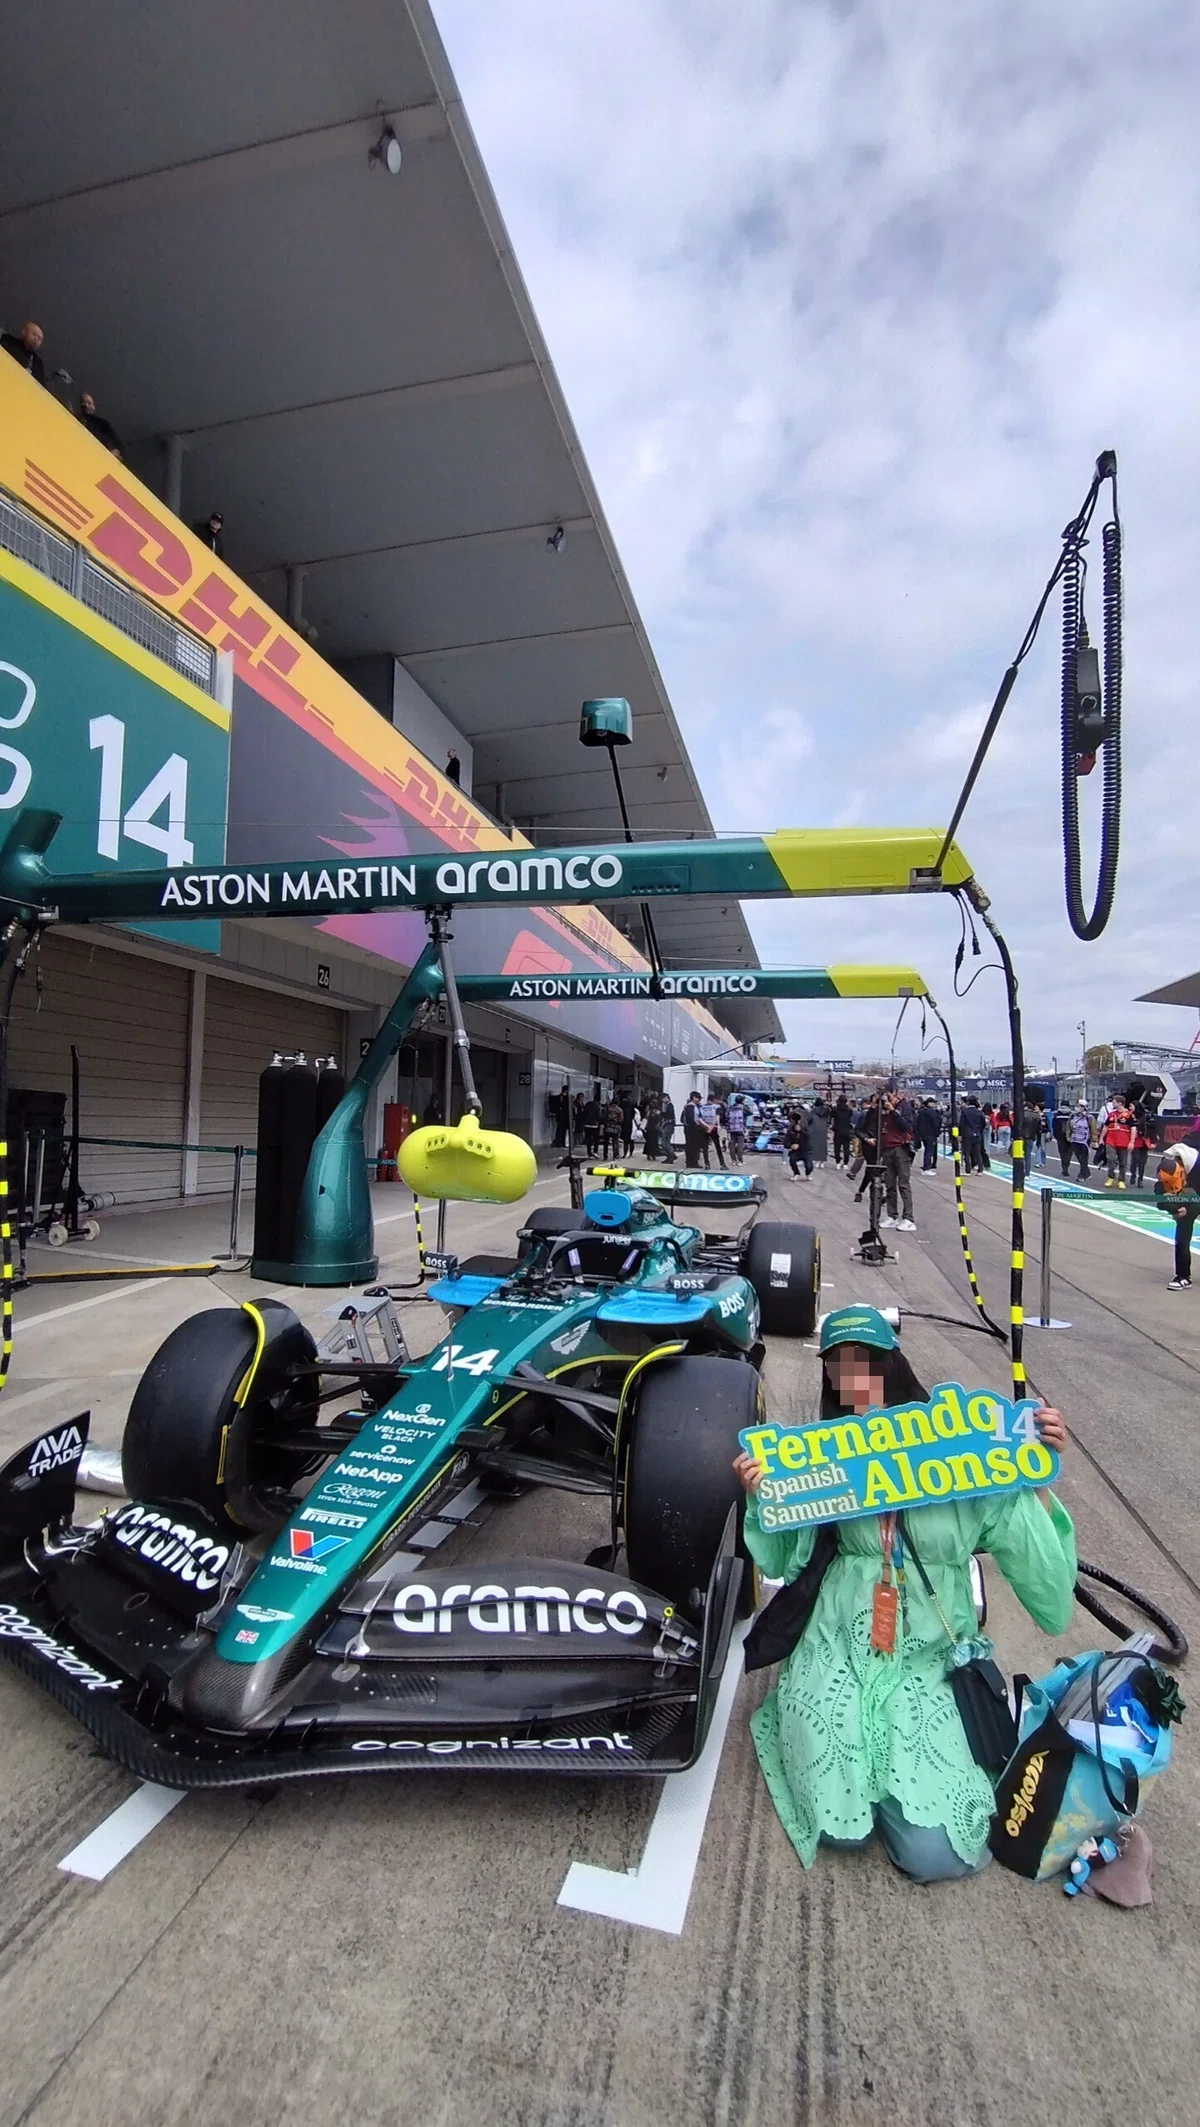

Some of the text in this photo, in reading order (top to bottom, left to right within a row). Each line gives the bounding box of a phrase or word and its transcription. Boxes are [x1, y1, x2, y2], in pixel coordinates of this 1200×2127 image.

[87, 474, 308, 709] DHL
[90, 714, 194, 868] 14
[404, 757, 482, 850] DHL
[161, 854, 623, 906] ASTON MARTIN aramco
[319, 969, 329, 985] 26
[510, 975, 757, 997] ASTON MARTIN aramco
[520, 1074, 531, 1085] 28
[986, 1079, 1007, 1087] MSC
[425, 1257, 447, 1269] BOSS
[673, 1280, 705, 1289] BOSS
[482, 1299, 564, 1311] BOMBARDIER
[719, 1291, 746, 1318] BOSS
[431, 1345, 499, 1376] 14
[382, 1409, 446, 1426] NexGen
[374, 1424, 436, 1439] VELOCITY
[381, 1433, 415, 1443] BLACK
[745, 1389, 1041, 1475] Fernando 14
[30, 1426, 82, 1464] AVA
[28, 1444, 82, 1477] TRADE
[349, 1450, 416, 1465] servicenow
[334, 1463, 403, 1483] NetApp
[760, 1463, 848, 1503] Spanish
[863, 1443, 1052, 1508] Alonso
[323, 1483, 387, 1499] Regent
[300, 1507, 367, 1529] PIRELLI
[763, 1489, 861, 1527] Samurai
[115, 1506, 229, 1590] aramco
[270, 1556, 327, 1575] Valvoline
[393, 1584, 647, 1635] aramco
[351, 1732, 634, 1754] cognizant
